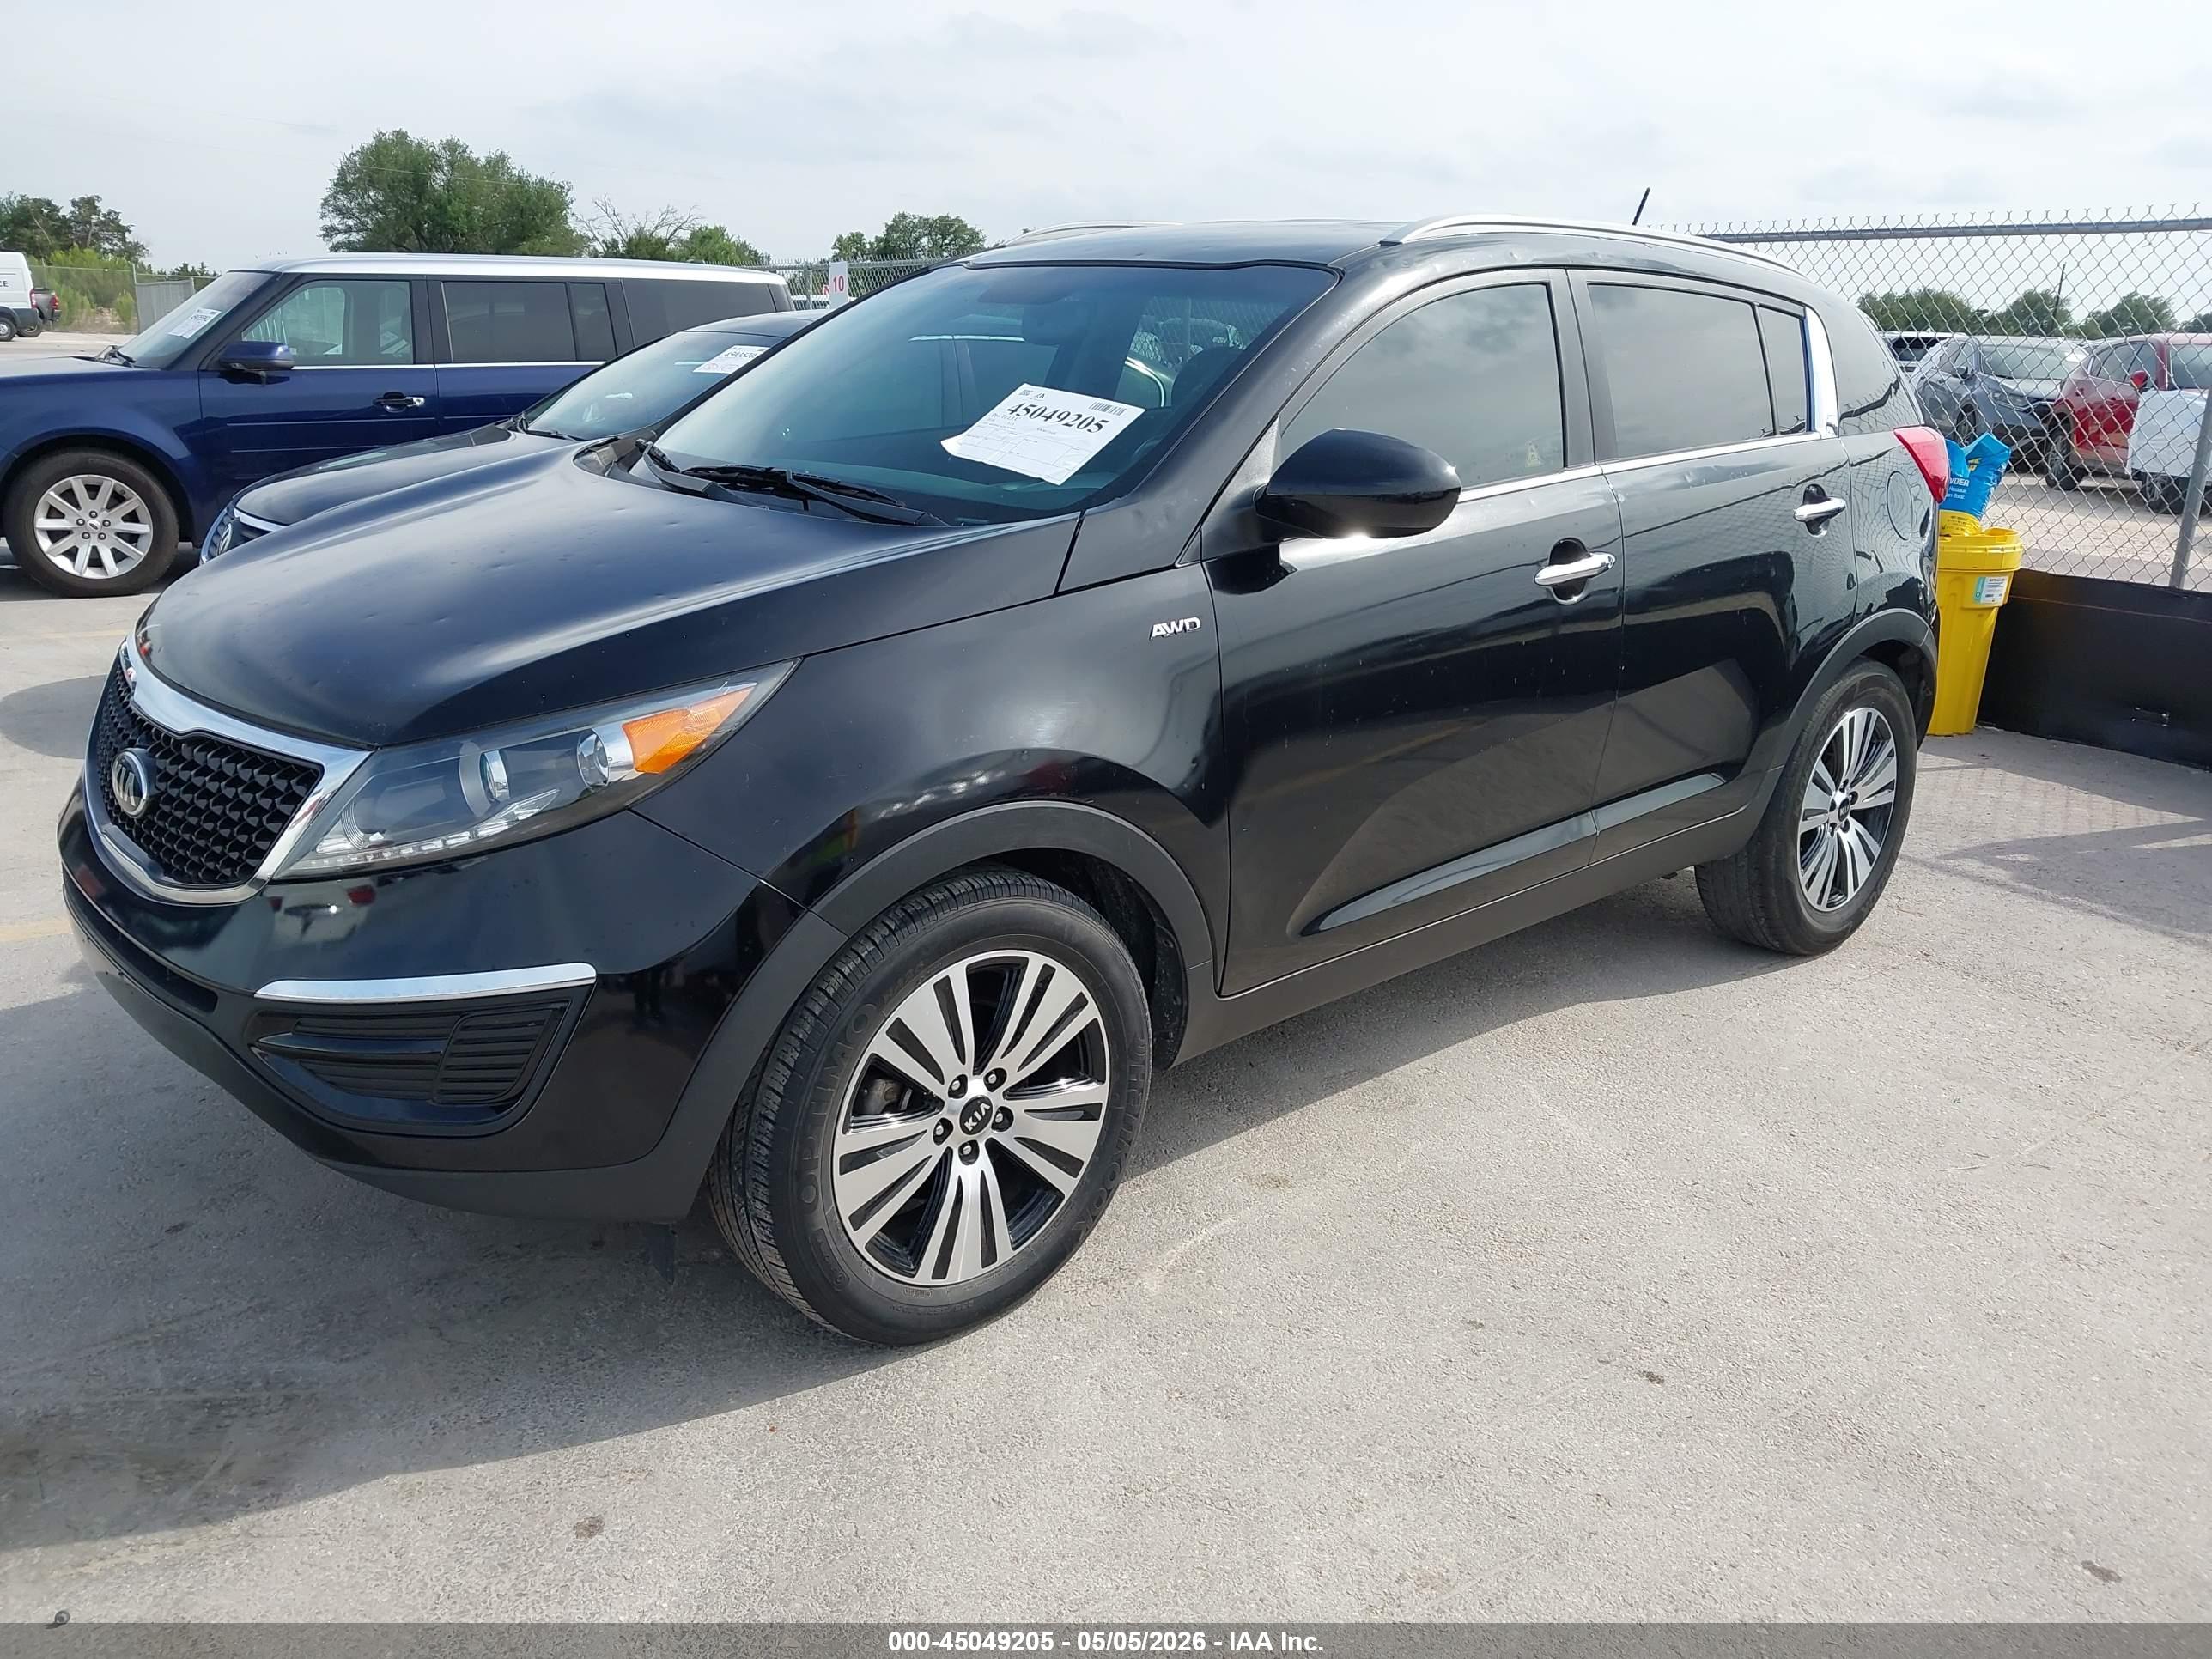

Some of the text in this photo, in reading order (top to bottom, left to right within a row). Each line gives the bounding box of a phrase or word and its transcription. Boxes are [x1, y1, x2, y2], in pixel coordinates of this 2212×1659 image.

[833, 276, 844, 292] 10
[1006, 402, 1110, 434] 45049205
[1149, 617, 1202, 640] AWD
[112, 760, 137, 807] KIA
[963, 1103, 991, 1132] KIA
